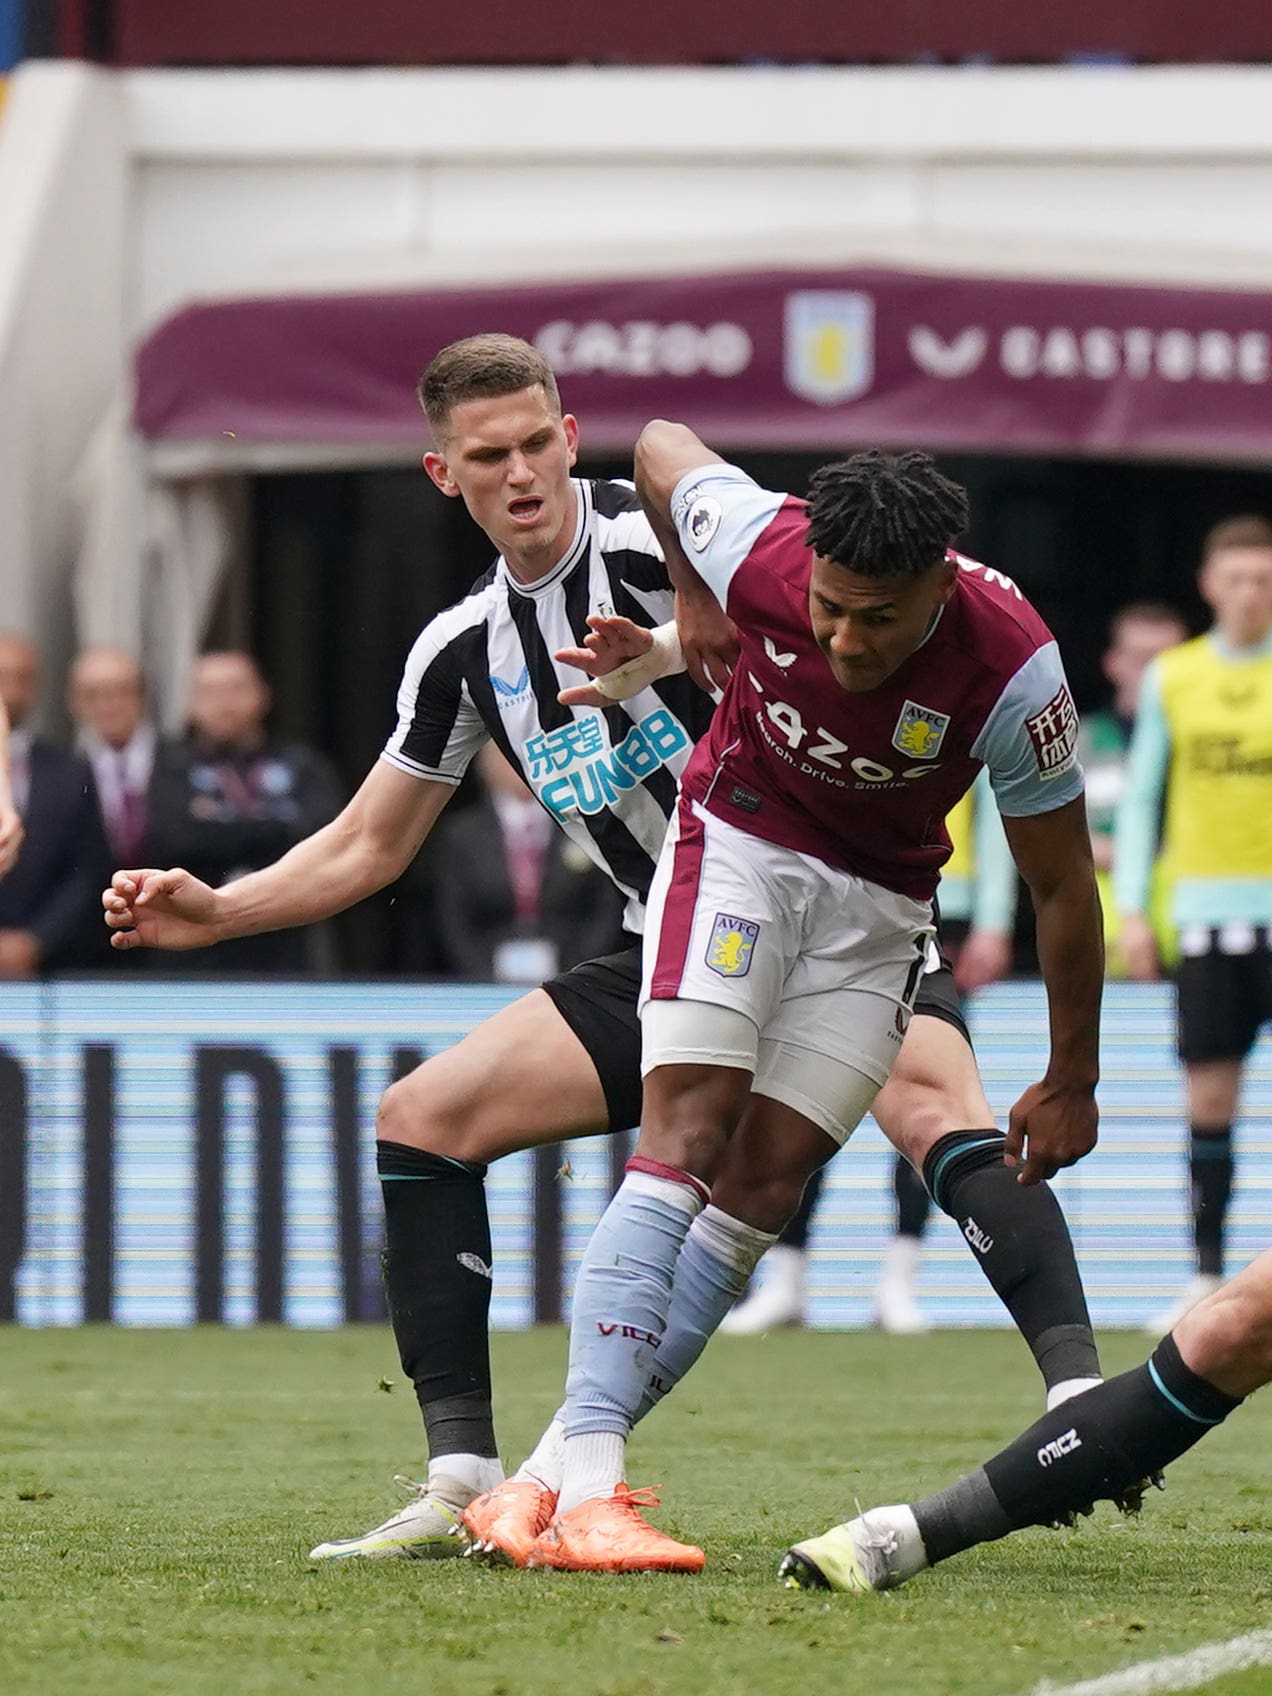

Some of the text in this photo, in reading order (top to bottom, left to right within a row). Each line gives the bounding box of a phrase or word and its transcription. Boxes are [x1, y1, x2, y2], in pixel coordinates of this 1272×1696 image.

[1000, 325, 1271, 384] CASTORE
[905, 707, 946, 728] AVFC
[524, 715, 604, 780] 乐天堂
[540, 709, 688, 824] FUN88
[717, 918, 757, 938] AVFC
